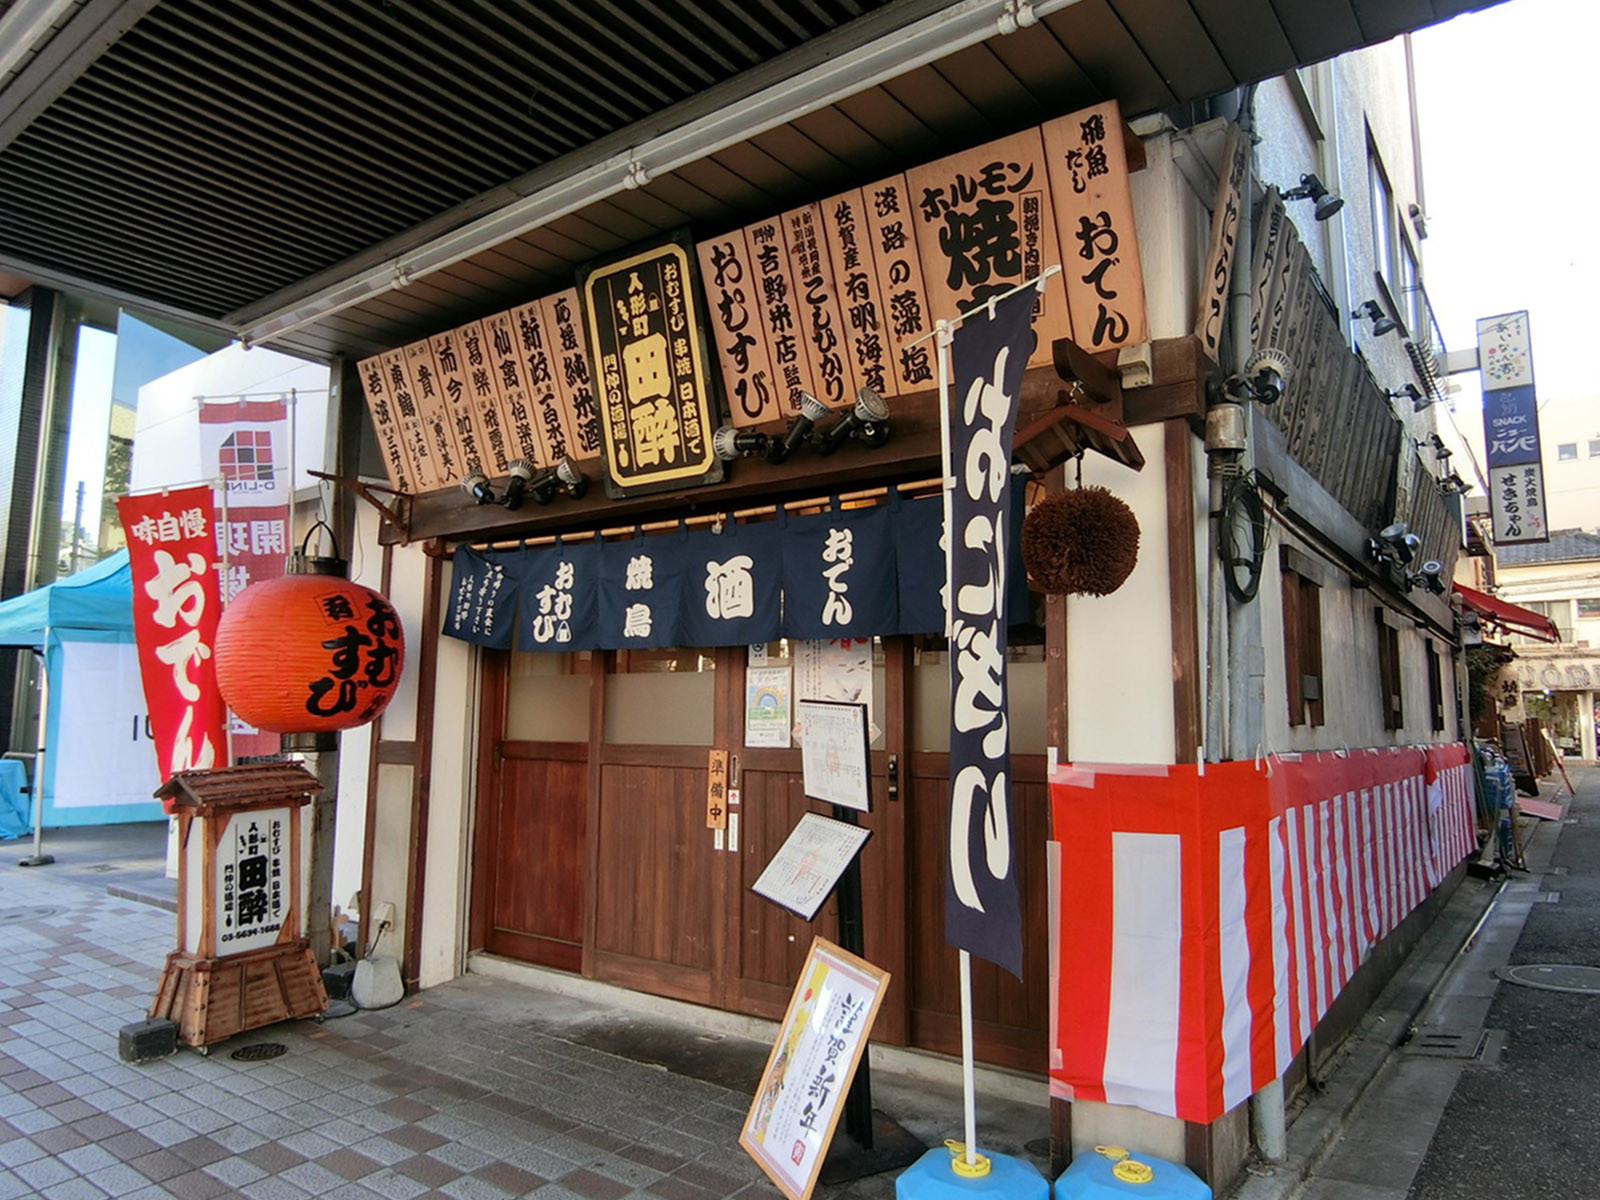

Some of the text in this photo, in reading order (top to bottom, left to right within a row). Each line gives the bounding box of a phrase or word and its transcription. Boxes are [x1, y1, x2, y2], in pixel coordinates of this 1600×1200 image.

[1065, 147, 1087, 194] だし
[1080, 114, 1109, 179] 飛魚
[920, 161, 1035, 222] ホルモン
[628, 272, 649, 336] 人形町
[834, 201, 886, 395] 佐賀産有明海苔
[874, 186, 933, 385] 淡路の藻塩
[1075, 211, 1130, 347] おでん
[493, 328, 520, 391] 仙禽
[519, 317, 553, 385] 新政
[664, 262, 701, 455] おむすび 串焼 日本酒で
[711, 242, 770, 418] おむすび
[804, 276, 845, 402] こしひかり
[417, 364, 436, 400] 貴
[439, 345, 464, 403] 而今
[553, 297, 601, 454] 応援純米酒
[622, 332, 680, 468] 田酔
[537, 393, 568, 462] 一白水成
[1492, 415, 1528, 427] SNACK
[131, 507, 207, 547] 味自慢
[1500, 473, 1522, 537] せきちゃん
[704, 555, 755, 620] 酒
[821, 527, 854, 626] おでん
[145, 550, 215, 775] おでん
[710, 758, 724, 825] 準備中
[239, 855, 268, 927] 田酔
